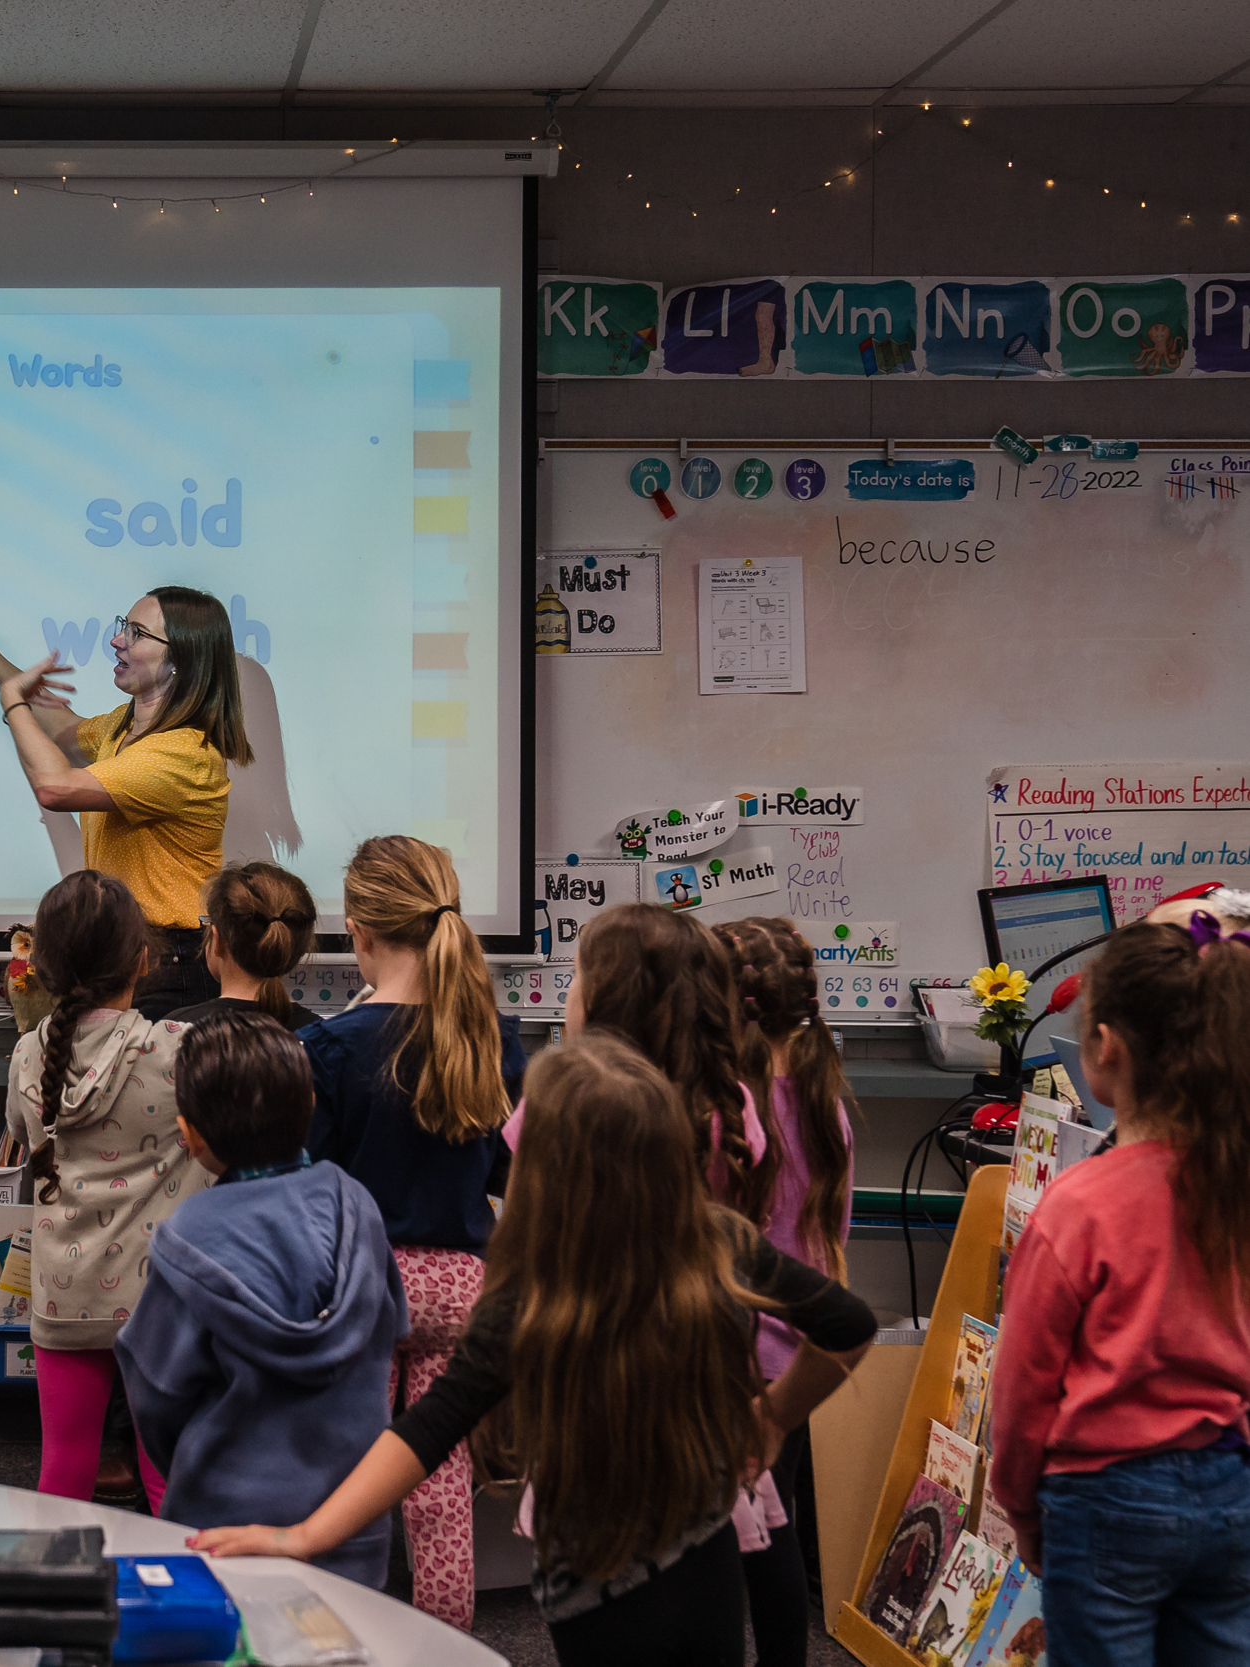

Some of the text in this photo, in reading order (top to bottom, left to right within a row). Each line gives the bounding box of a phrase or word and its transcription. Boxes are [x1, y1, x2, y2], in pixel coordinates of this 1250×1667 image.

[543, 286, 610, 338] Kk
[802, 288, 893, 337] Mm
[935, 288, 1005, 340] Nn
[1066, 286, 1142, 339] Oo
[9, 354, 122, 388] Words
[1002, 435, 1031, 460] month
[1058, 438, 1078, 450] day
[1104, 446, 1128, 456] year
[640, 462, 663, 474] level
[690, 462, 712, 474] level
[743, 463, 764, 474] level
[794, 463, 817, 474] level
[642, 475, 658, 498] 0
[744, 475, 759, 498] 2
[797, 475, 812, 500] 3
[850, 471, 970, 489] Today's date is
[86, 477, 243, 549] said
[834, 515, 997, 566] because
[559, 564, 631, 593] Must
[577, 609, 616, 634] Do
[761, 792, 857, 821] i-Ready
[1017, 777, 1095, 814] Reading
[1104, 777, 1185, 805] Stations
[652, 808, 725, 830] Tech Your
[1018, 818, 1058, 842] 0-1
[1064, 825, 1113, 842] voice
[655, 825, 726, 847] Monster to
[789, 827, 840, 850] Typing
[807, 843, 839, 861] Club
[994, 846, 1012, 868] 2.
[1019, 842, 1066, 873] Stay
[1074, 841, 1143, 866] focused
[1151, 841, 1187, 866] and
[1192, 848, 1214, 865] on
[701, 862, 775, 890] ST Math
[787, 856, 846, 890] Read
[1135, 875, 1164, 891] me
[545, 873, 605, 907] May
[788, 890, 853, 918] Write
[812, 944, 895, 964] artyAnts
[289, 971, 307, 986] 42
[316, 970, 335, 986] 43
[503, 973, 573, 988] 50 51 52
[824, 976, 844, 992] 62
[852, 976, 872, 992] 63
[879, 976, 898, 992] 64
